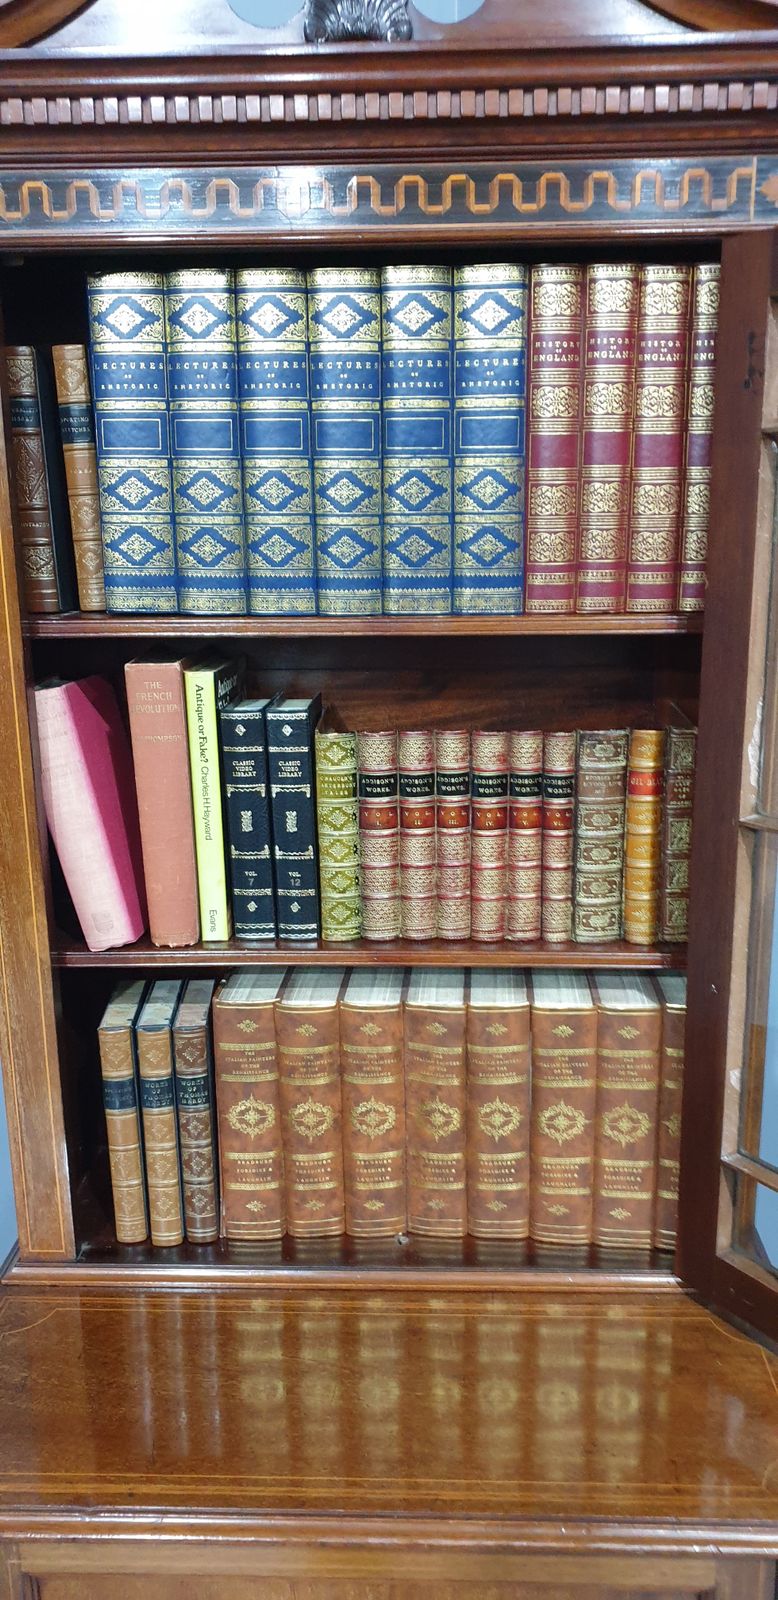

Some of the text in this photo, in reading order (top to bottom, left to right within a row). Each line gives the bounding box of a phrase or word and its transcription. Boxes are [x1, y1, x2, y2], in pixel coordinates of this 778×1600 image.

[95, 362, 163, 370] LECTURES
[311, 361, 378, 369] LECTURES
[143, 681, 163, 689] THE
[135, 691, 172, 701] FRENCH
[195, 684, 204, 724] Antique
[198, 725, 206, 736] or
[199, 736, 210, 764] Fake?
[201, 766, 210, 797] Charles
[203, 805, 213, 842] Hayward
[248, 878, 254, 886] 7
[290, 879, 301, 887] 12
[209, 909, 218, 933] Evans
